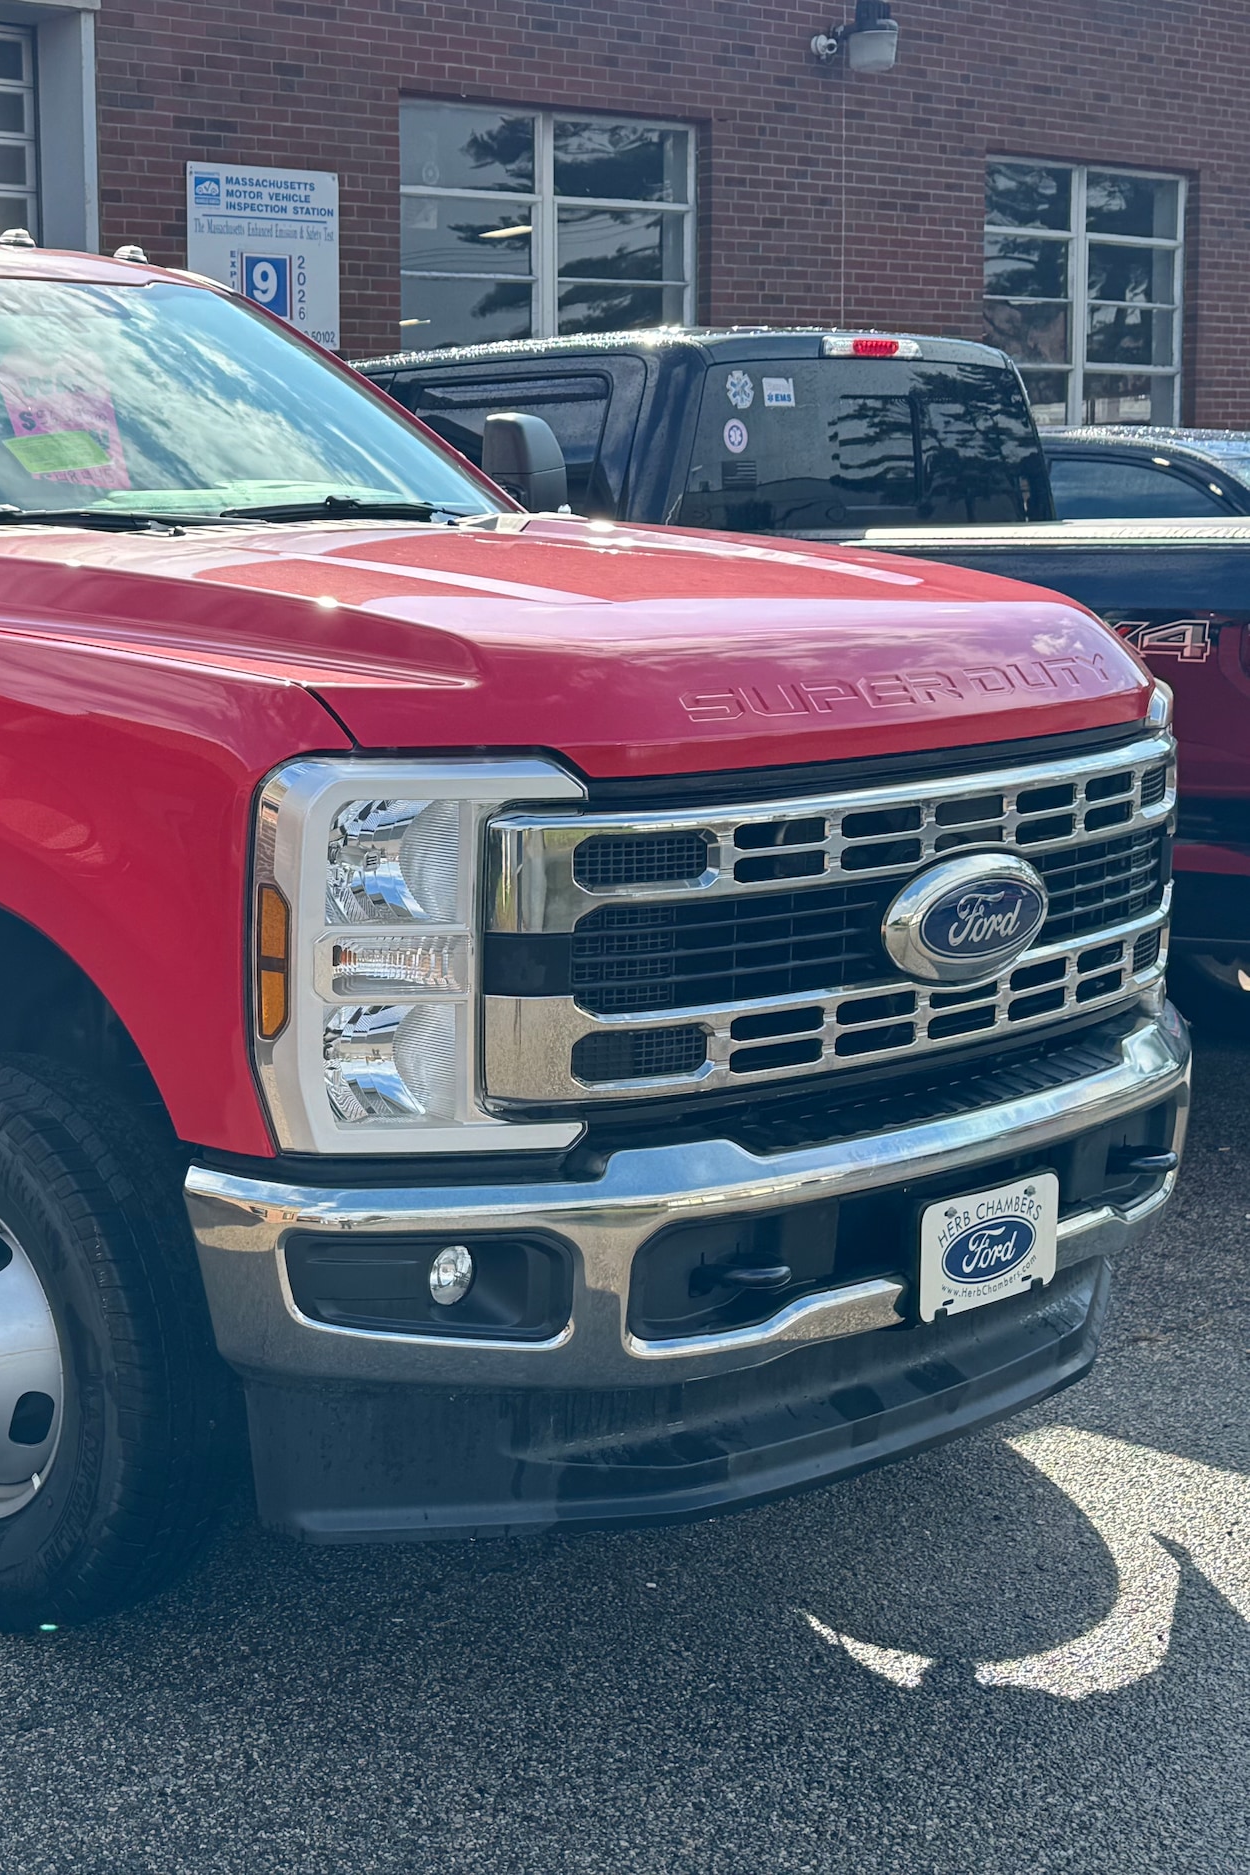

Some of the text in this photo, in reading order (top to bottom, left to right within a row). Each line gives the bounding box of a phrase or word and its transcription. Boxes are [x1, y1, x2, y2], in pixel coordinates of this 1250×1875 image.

[225, 176, 315, 192] MASSACHUSETTS
[225, 189, 263, 201] MOTOR
[268, 192, 311, 204] VEHICLE
[225, 201, 288, 214] INSPECTION
[292, 205, 334, 217] STATION
[194, 218, 205, 233] The
[207, 219, 245, 236] Massachusetts
[247, 222, 273, 238] Enhanced
[306, 226, 321, 246] Safety
[323, 226, 335, 242] Test
[252, 261, 278, 303] 9
[774, 393, 792, 402] EMS
[679, 652, 1109, 722] SUPER DUTY
[948, 890, 1021, 947] Ford
[937, 1196, 1042, 1248] HERB CHAMBERS
[962, 1226, 1018, 1274] Ford
[941, 1254, 1037, 1298] www.HerbChambers.com
